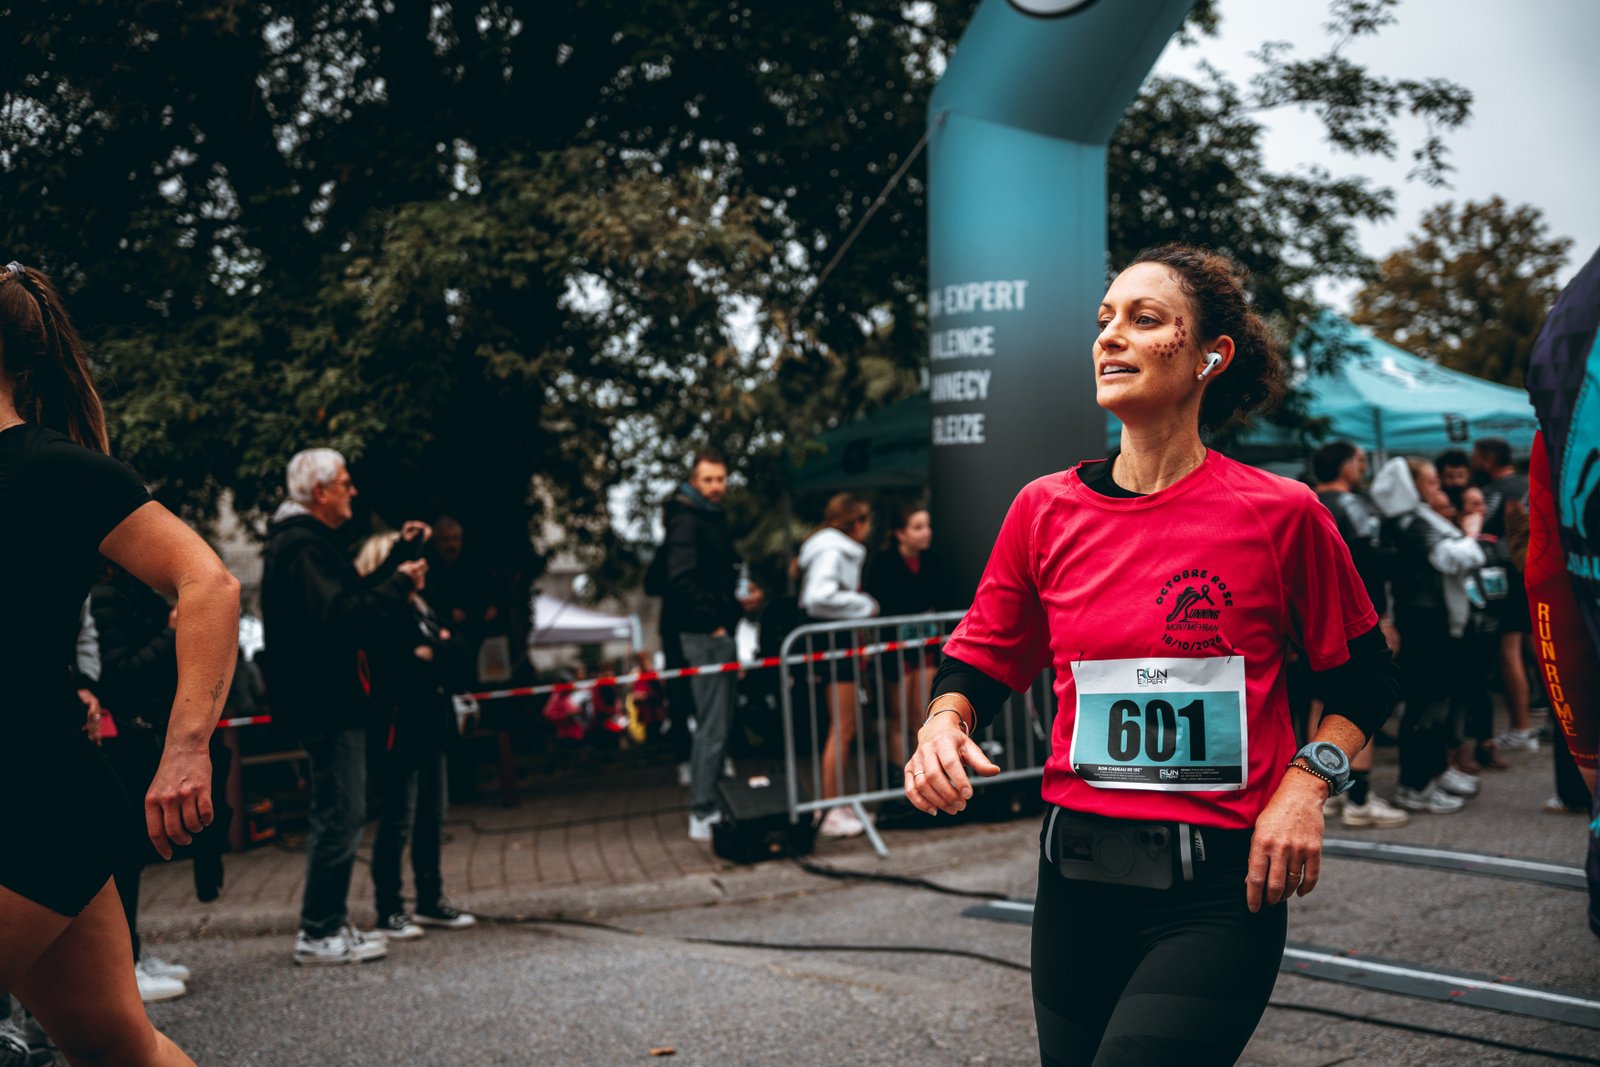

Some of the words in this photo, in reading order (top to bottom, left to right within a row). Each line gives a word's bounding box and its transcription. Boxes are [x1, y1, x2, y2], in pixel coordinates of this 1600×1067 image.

[1156, 569, 1208, 605] OCTOBRE
[1211, 576, 1233, 607] ROSE
[1165, 623, 1219, 632] MONTMEYRAN
[1538, 602, 1556, 661] RUN
[1137, 667, 1168, 679] RUN
[1545, 663, 1577, 737] ROME
[1107, 699, 1206, 762] 601
